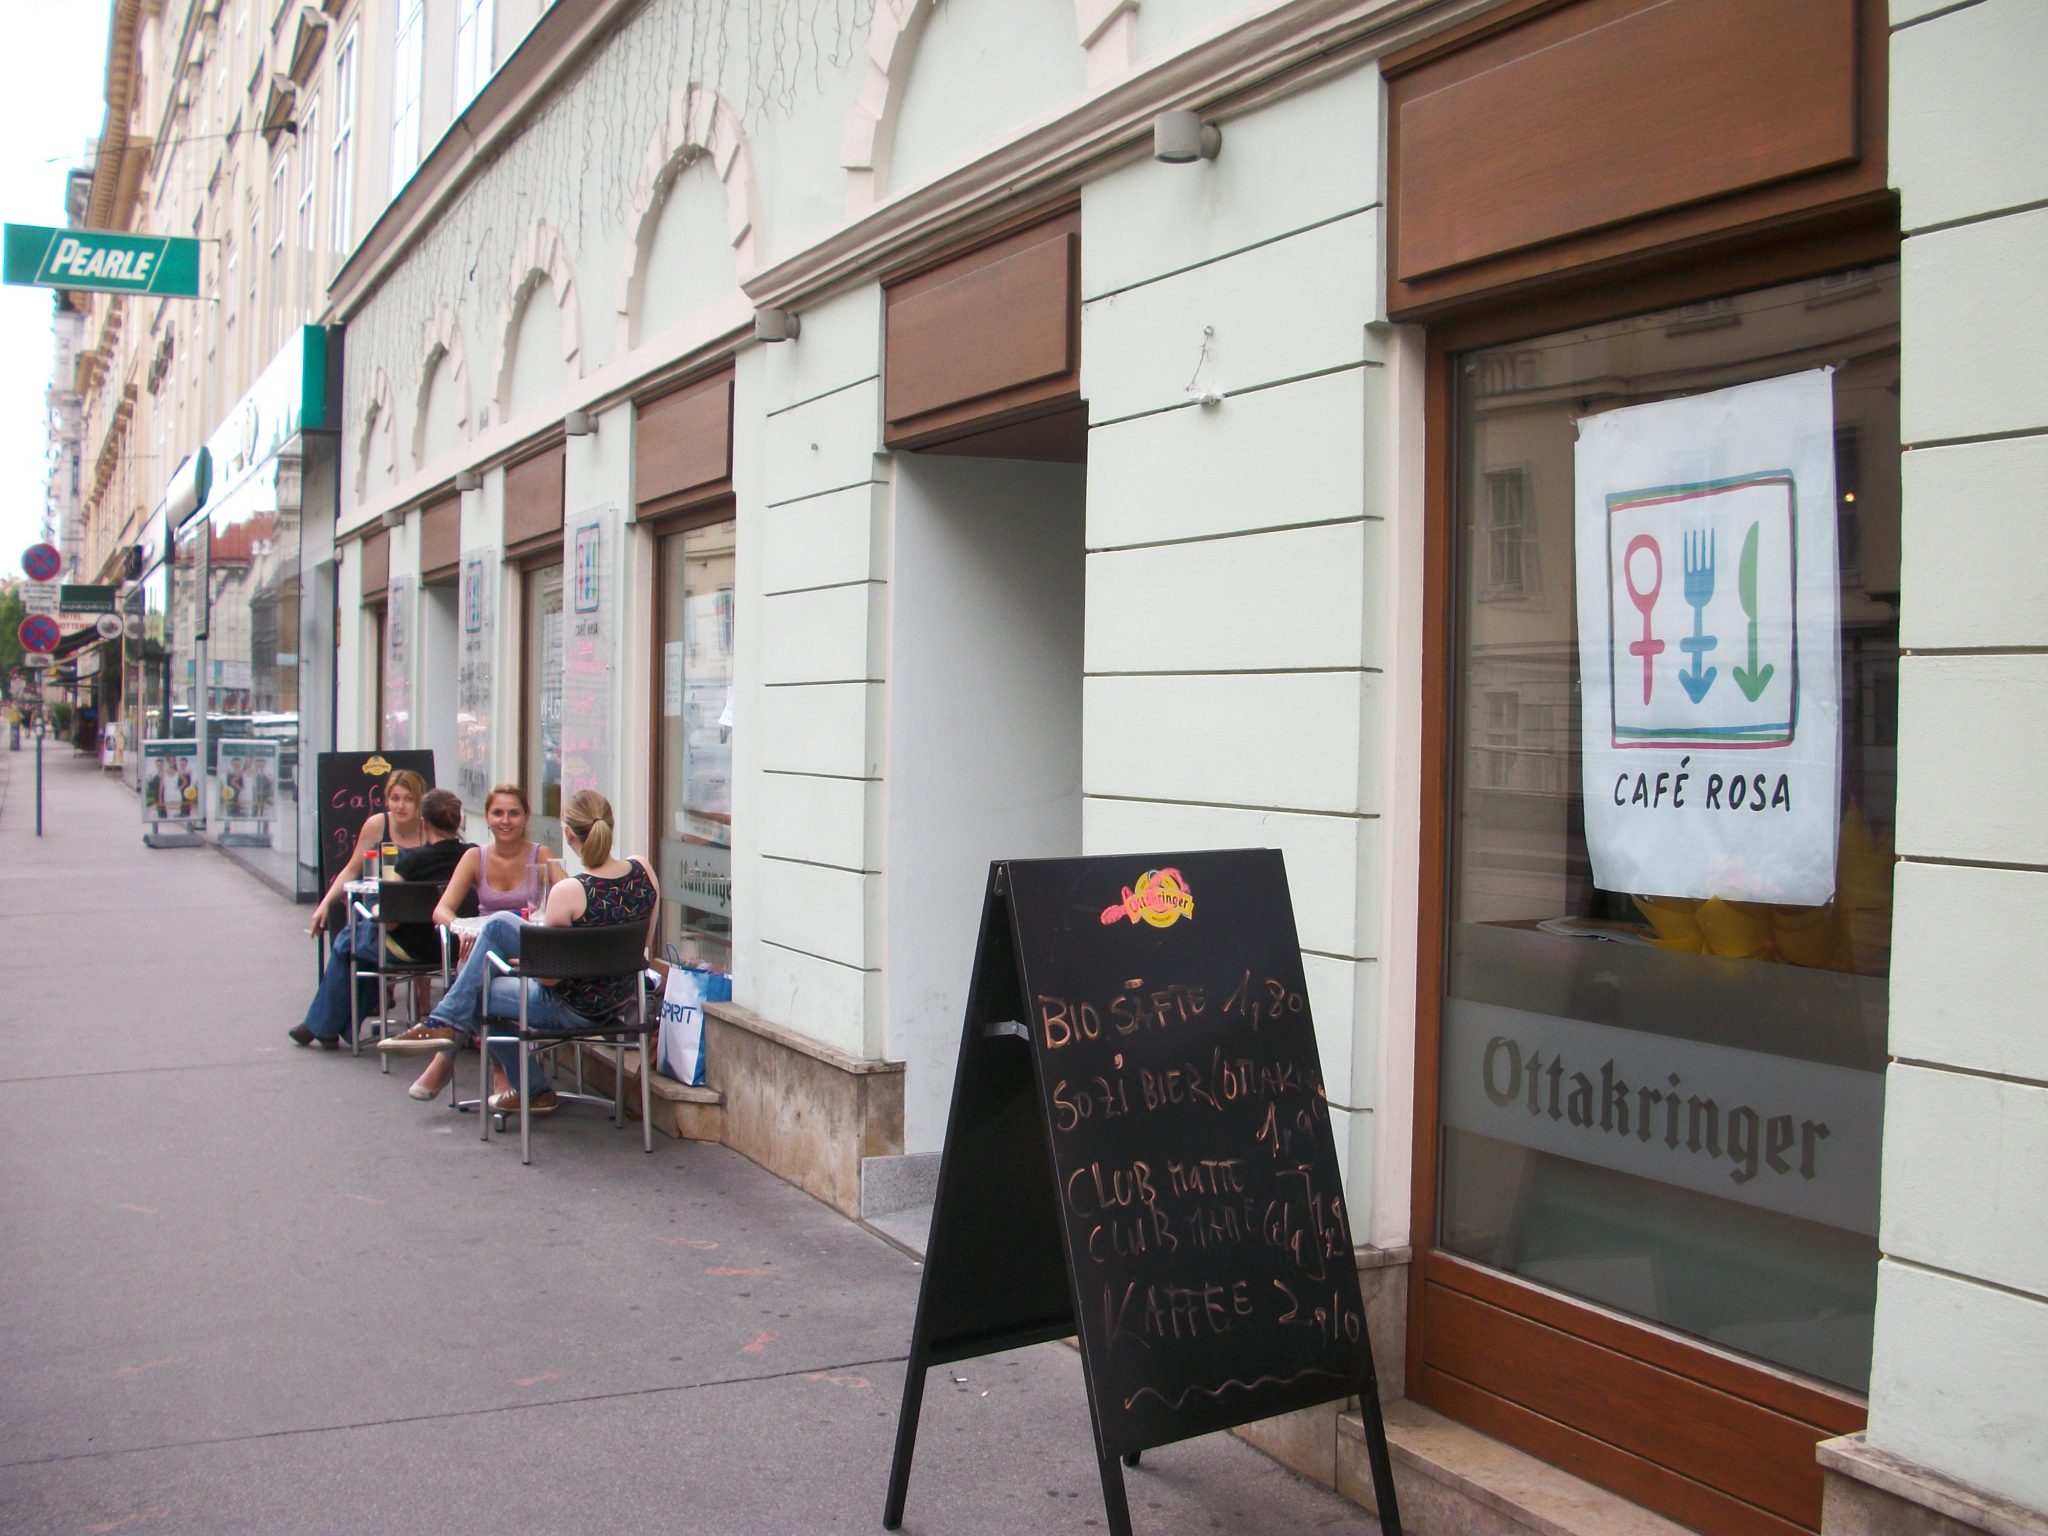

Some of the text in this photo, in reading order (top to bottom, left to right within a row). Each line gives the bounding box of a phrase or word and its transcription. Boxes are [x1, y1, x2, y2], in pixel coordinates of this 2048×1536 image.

[50, 237, 156, 281] PEARLE
[1613, 755, 1791, 813] CAFÉ ROSA
[333, 827, 356, 857] Bi
[660, 1000, 697, 1024] SPRIT
[1038, 993, 1101, 1049] BIO
[1482, 1034, 1831, 1185] Ottakringer
